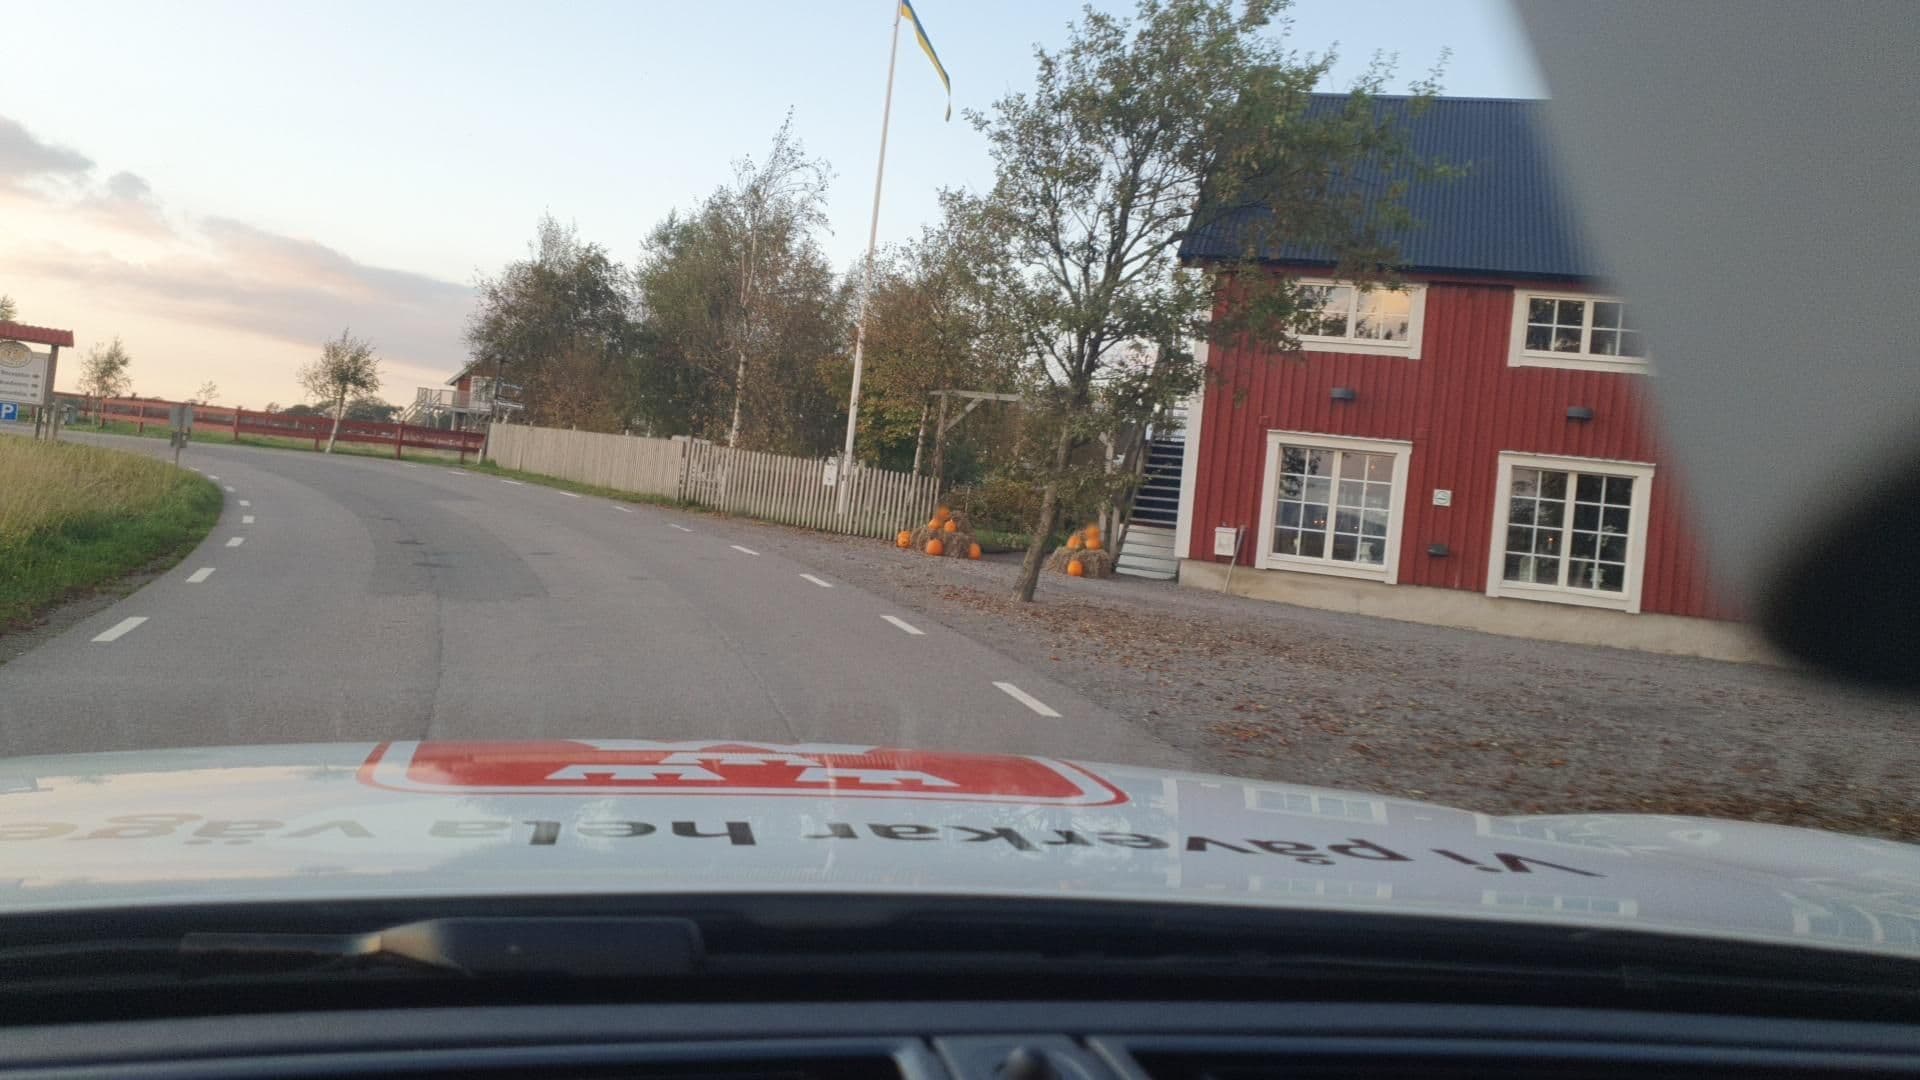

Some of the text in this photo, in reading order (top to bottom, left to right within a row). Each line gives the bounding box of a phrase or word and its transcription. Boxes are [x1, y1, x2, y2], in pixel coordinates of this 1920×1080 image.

[1, 403, 14, 419] P
[428, 819, 757, 846] hela
[804, 822, 1415, 866] påverkar
[1430, 848, 1608, 878] Vi
